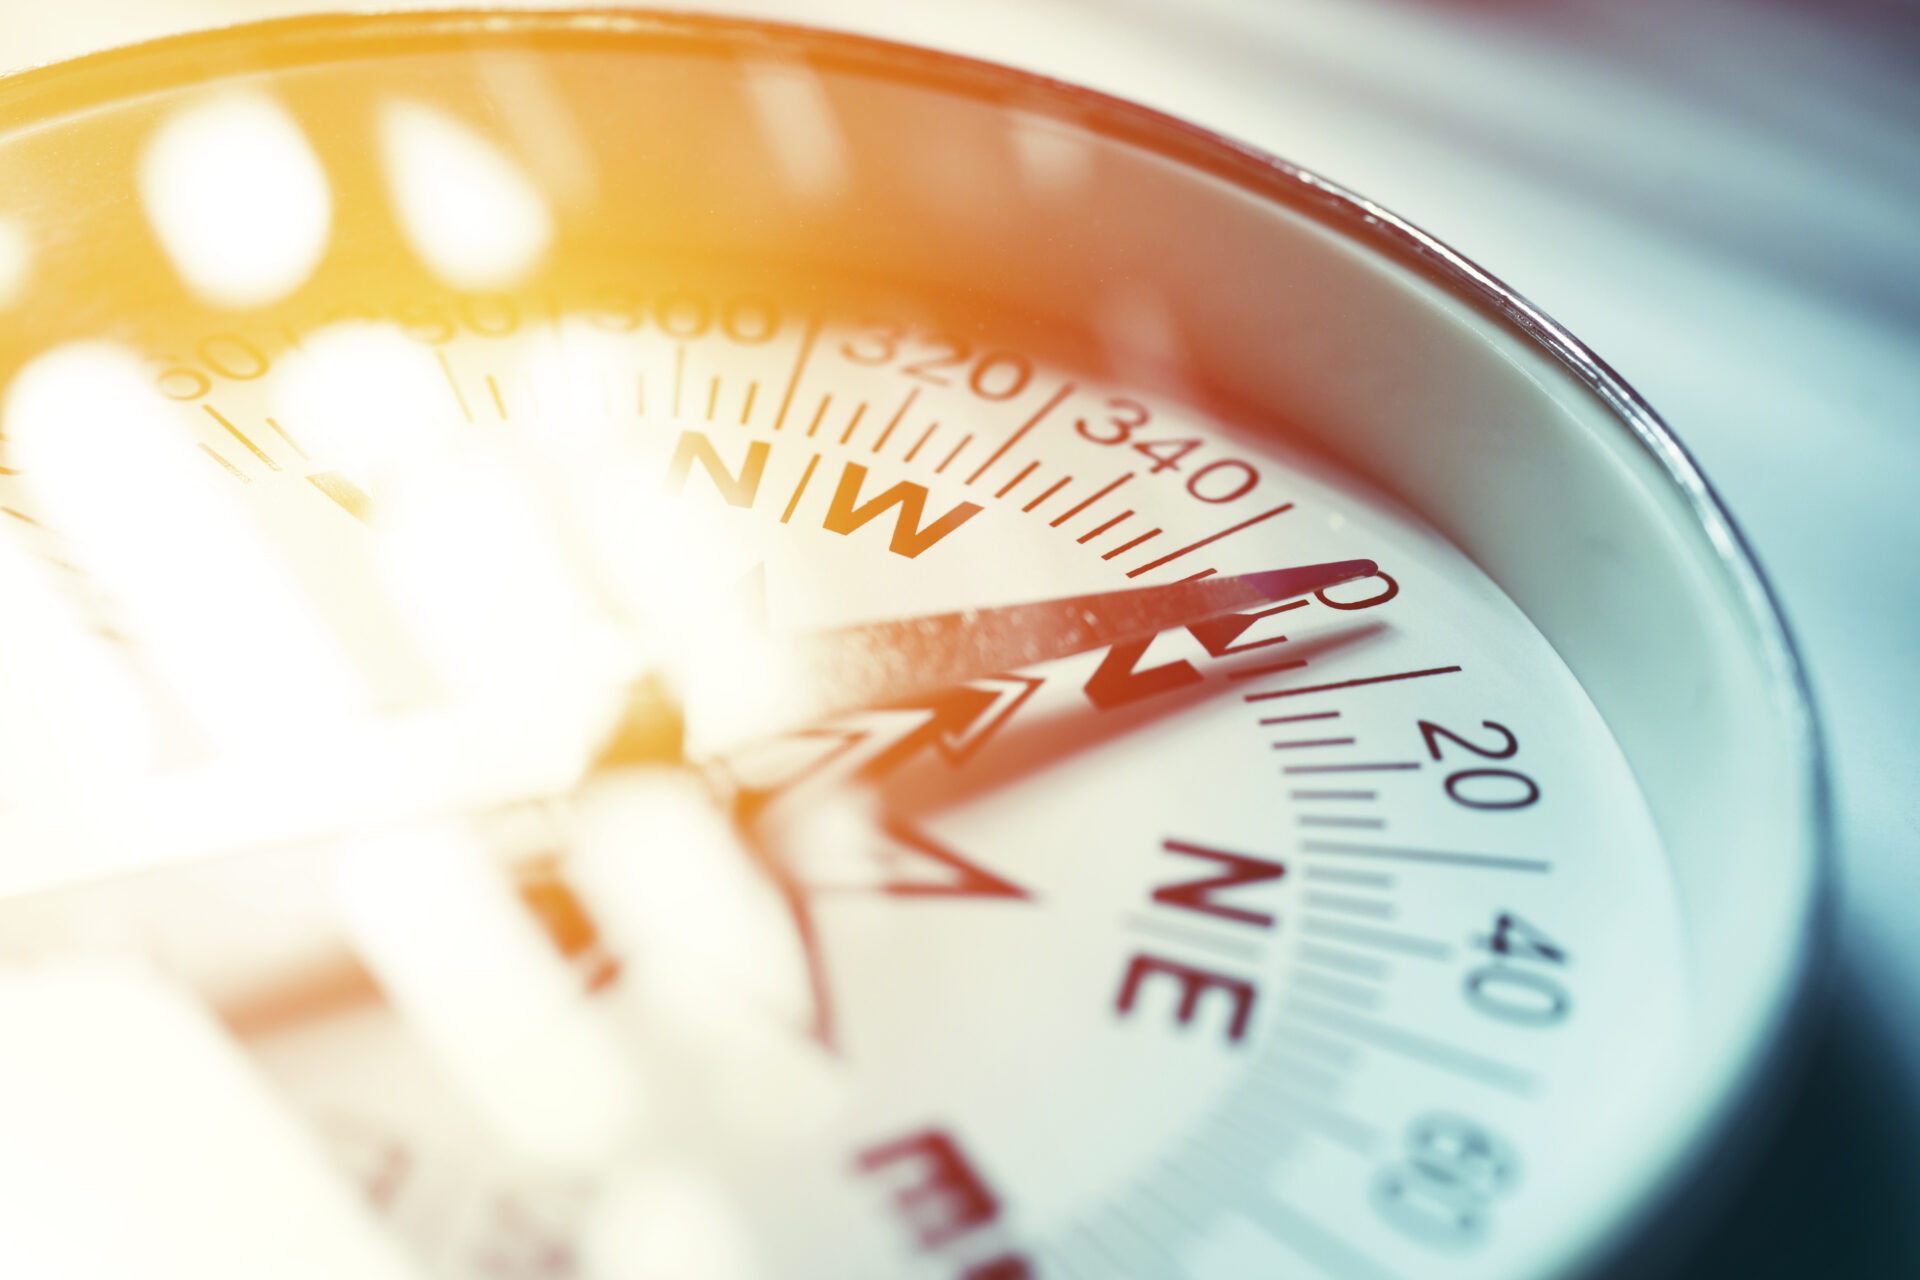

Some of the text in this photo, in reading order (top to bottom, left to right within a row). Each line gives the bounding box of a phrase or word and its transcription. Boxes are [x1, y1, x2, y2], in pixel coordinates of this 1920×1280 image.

[592, 286, 783, 346] 300
[839, 318, 1036, 403] 320
[1074, 397, 1260, 505] 340
[1416, 719, 1542, 812] 20
[1113, 836, 1288, 1046] NE
[1462, 907, 1575, 1032] 40
[1367, 1106, 1526, 1260] 60
